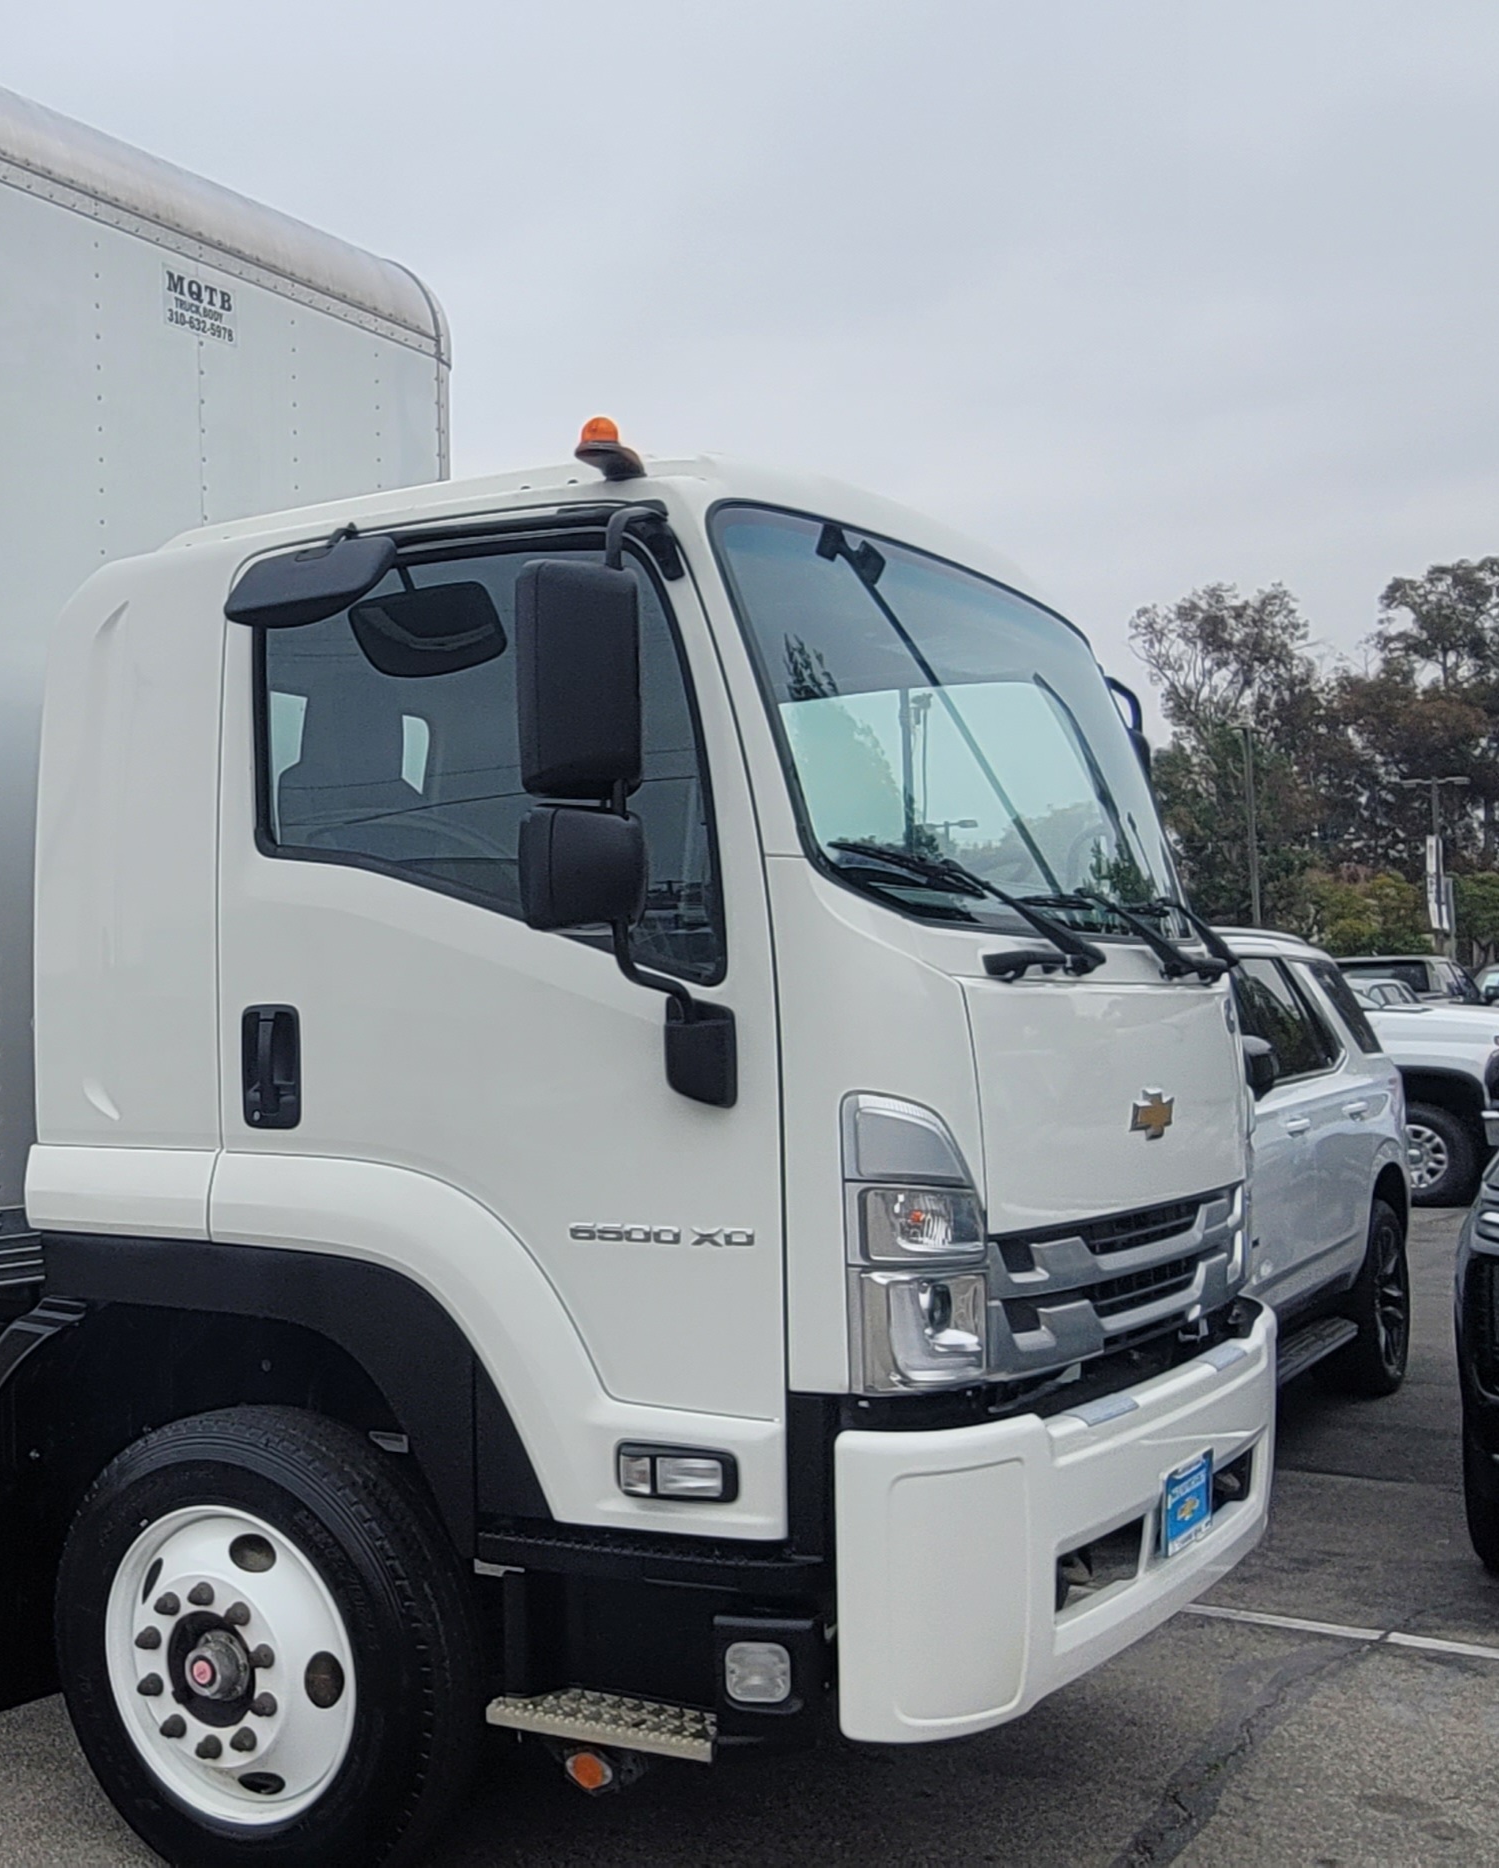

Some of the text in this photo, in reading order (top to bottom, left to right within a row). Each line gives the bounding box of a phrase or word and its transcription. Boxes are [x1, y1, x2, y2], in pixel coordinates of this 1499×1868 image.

[166, 270, 232, 312] MQTB
[174, 296, 223, 324] TRUCK BODY
[569, 1222, 681, 1245] 6500
